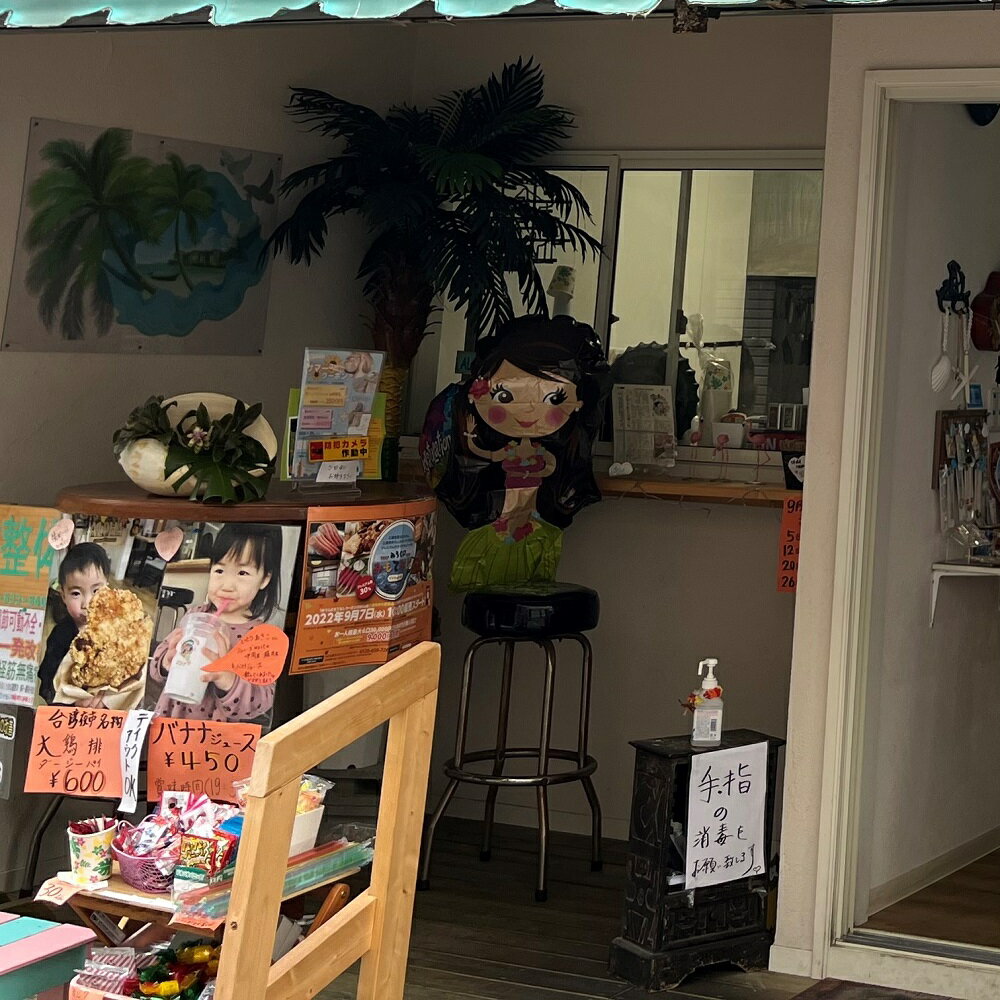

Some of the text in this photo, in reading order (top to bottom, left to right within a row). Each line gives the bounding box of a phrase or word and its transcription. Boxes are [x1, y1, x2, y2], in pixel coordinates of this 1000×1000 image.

[341, 448, 368, 457] 作動中
[152, 722, 257, 752] バナナジュース
[164, 751, 239, 772] ¥450
[49, 770, 104, 793] ¥600
[713, 806, 728, 821] の
[693, 825, 748, 848] 消毒を
